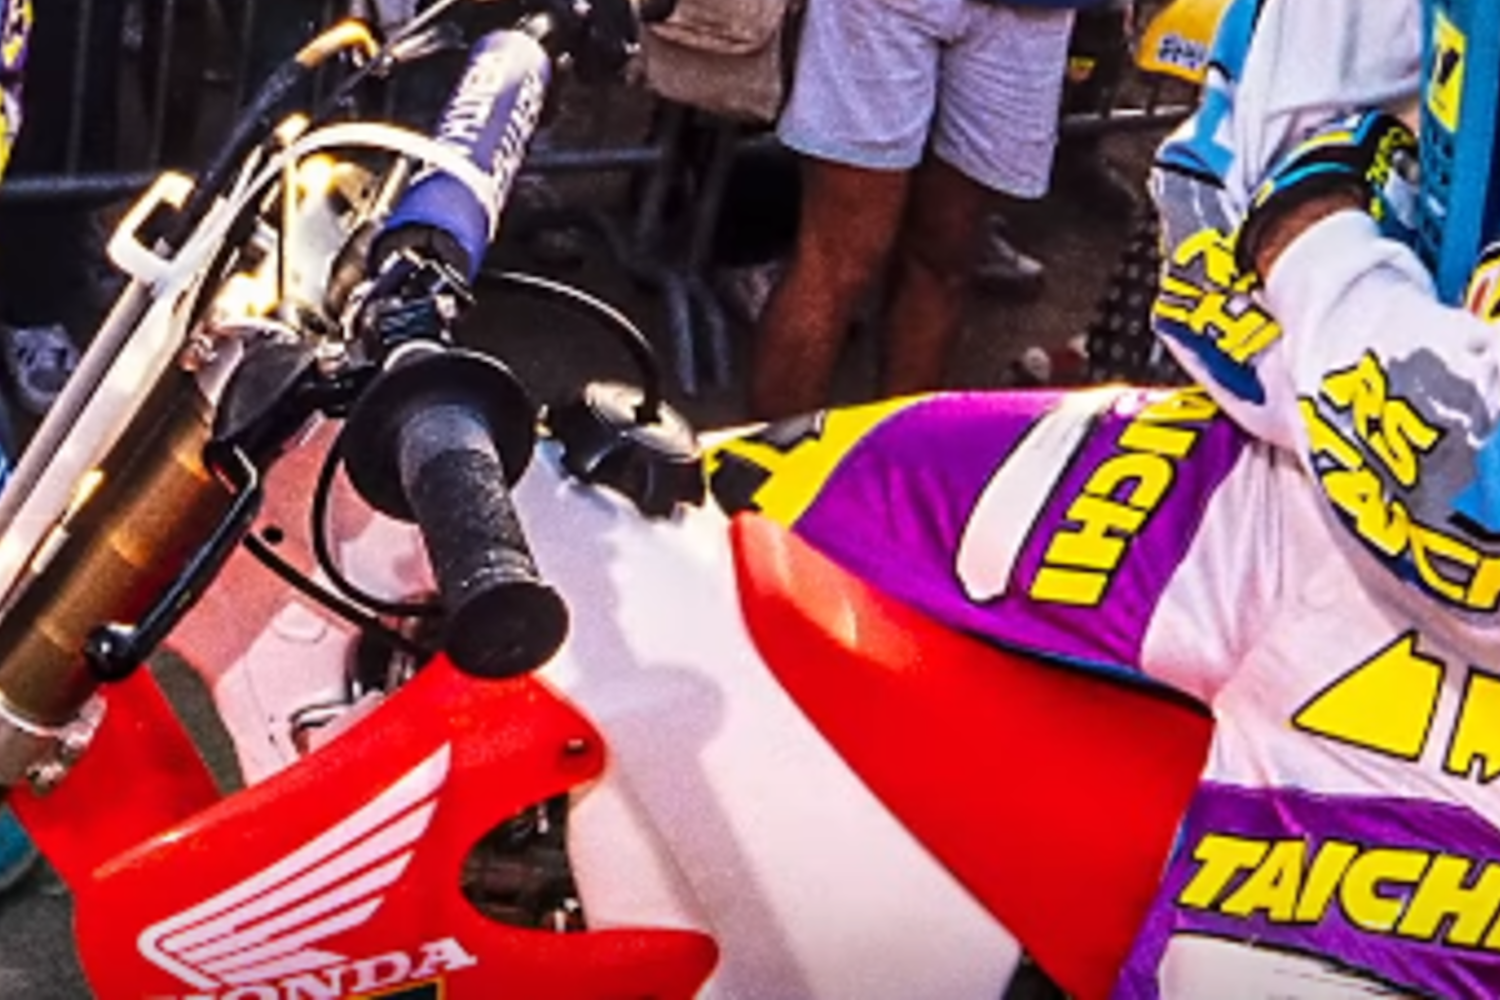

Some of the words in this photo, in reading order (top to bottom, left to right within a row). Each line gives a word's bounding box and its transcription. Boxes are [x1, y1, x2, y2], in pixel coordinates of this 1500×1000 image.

[1320, 350, 1441, 487] RS
[1177, 833, 1500, 950] TAICH
[147, 936, 478, 1000] ONDA
